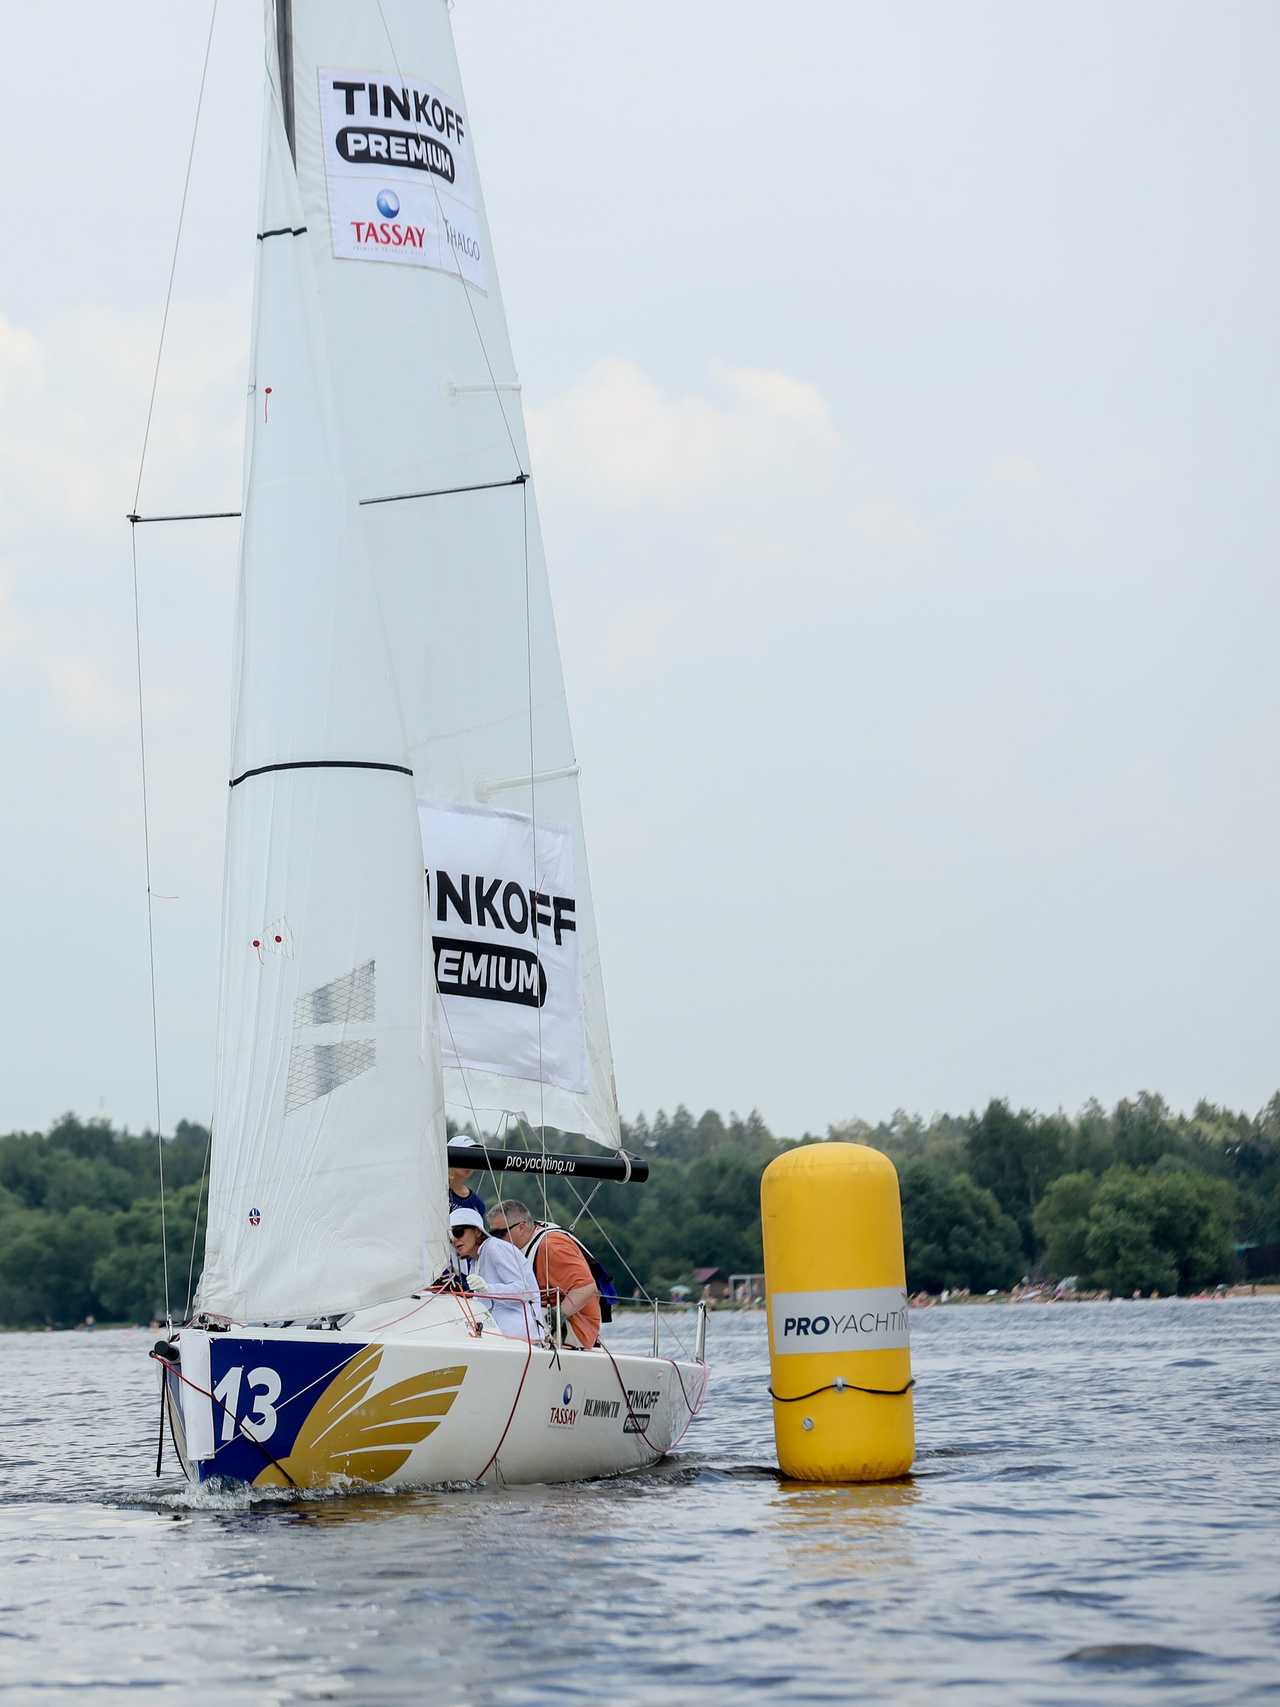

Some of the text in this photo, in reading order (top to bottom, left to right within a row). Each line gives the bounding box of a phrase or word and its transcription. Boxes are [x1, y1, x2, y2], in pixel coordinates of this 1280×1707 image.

[332, 81, 465, 146] TINKOFF
[346, 132, 452, 178] PREMIUM
[350, 222, 426, 248] TASSAY
[443, 217, 480, 261] THALGO
[425, 868, 576, 946] NKOFF
[437, 948, 539, 997] EMIUM
[504, 1155, 576, 1175] pro-yachting.ru
[783, 1311, 909, 1337] PROYACHTIN
[213, 1367, 282, 1443] 13
[550, 1407, 578, 1425] TASSAY
[626, 1390, 661, 1410] TINKOFF
